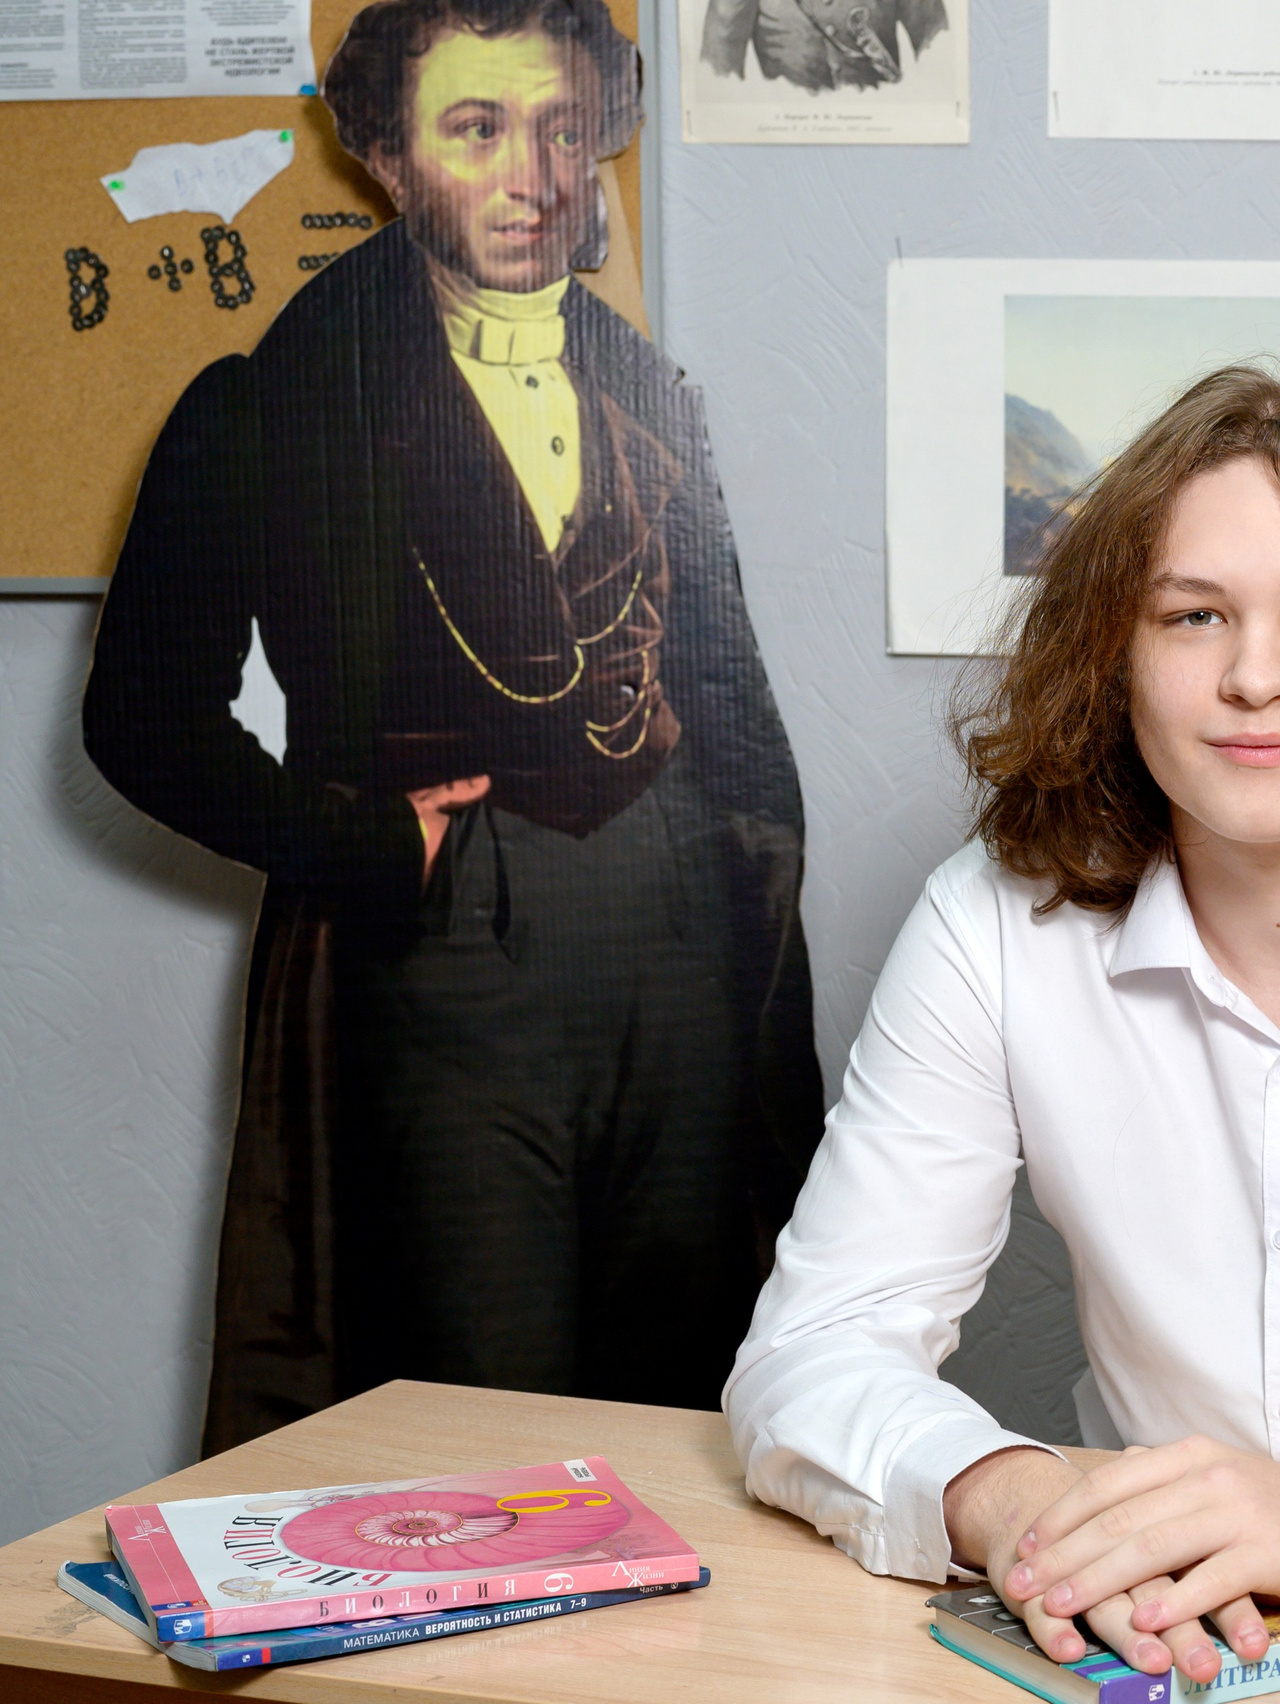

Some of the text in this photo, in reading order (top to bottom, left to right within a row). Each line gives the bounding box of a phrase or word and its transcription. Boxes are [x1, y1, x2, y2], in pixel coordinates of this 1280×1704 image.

[319, 1579, 516, 1617] БИОЛОГИЯ
[640, 1585, 664, 1594] Часть
[343, 1628, 420, 1649] МАТЕМАТИКА
[425, 1614, 492, 1635] ВЕРОЯТНОСТЬ
[494, 1612, 501, 1623] И
[503, 1602, 562, 1622] СТАТИСТИКА
